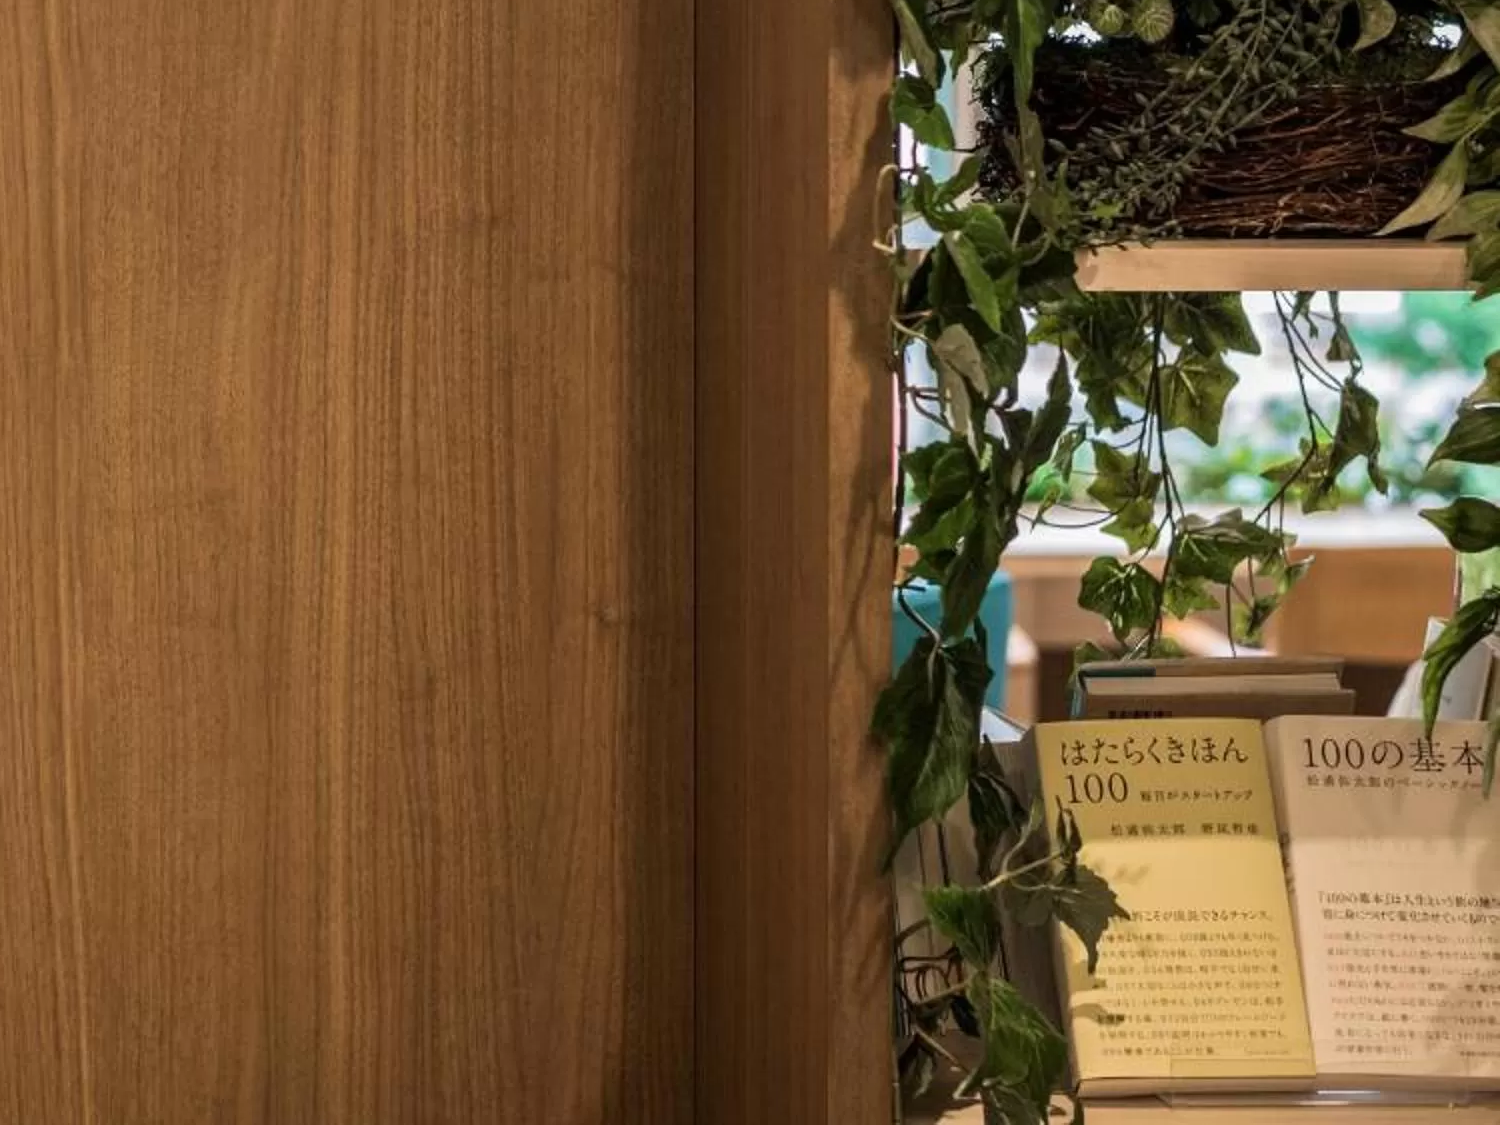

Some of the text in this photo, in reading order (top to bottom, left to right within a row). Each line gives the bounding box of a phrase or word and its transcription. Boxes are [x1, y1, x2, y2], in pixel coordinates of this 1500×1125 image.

[1061, 736, 1249, 766] はたらくきほん
[1303, 738, 1484, 775] 100の基本
[1065, 771, 1129, 804] 100
